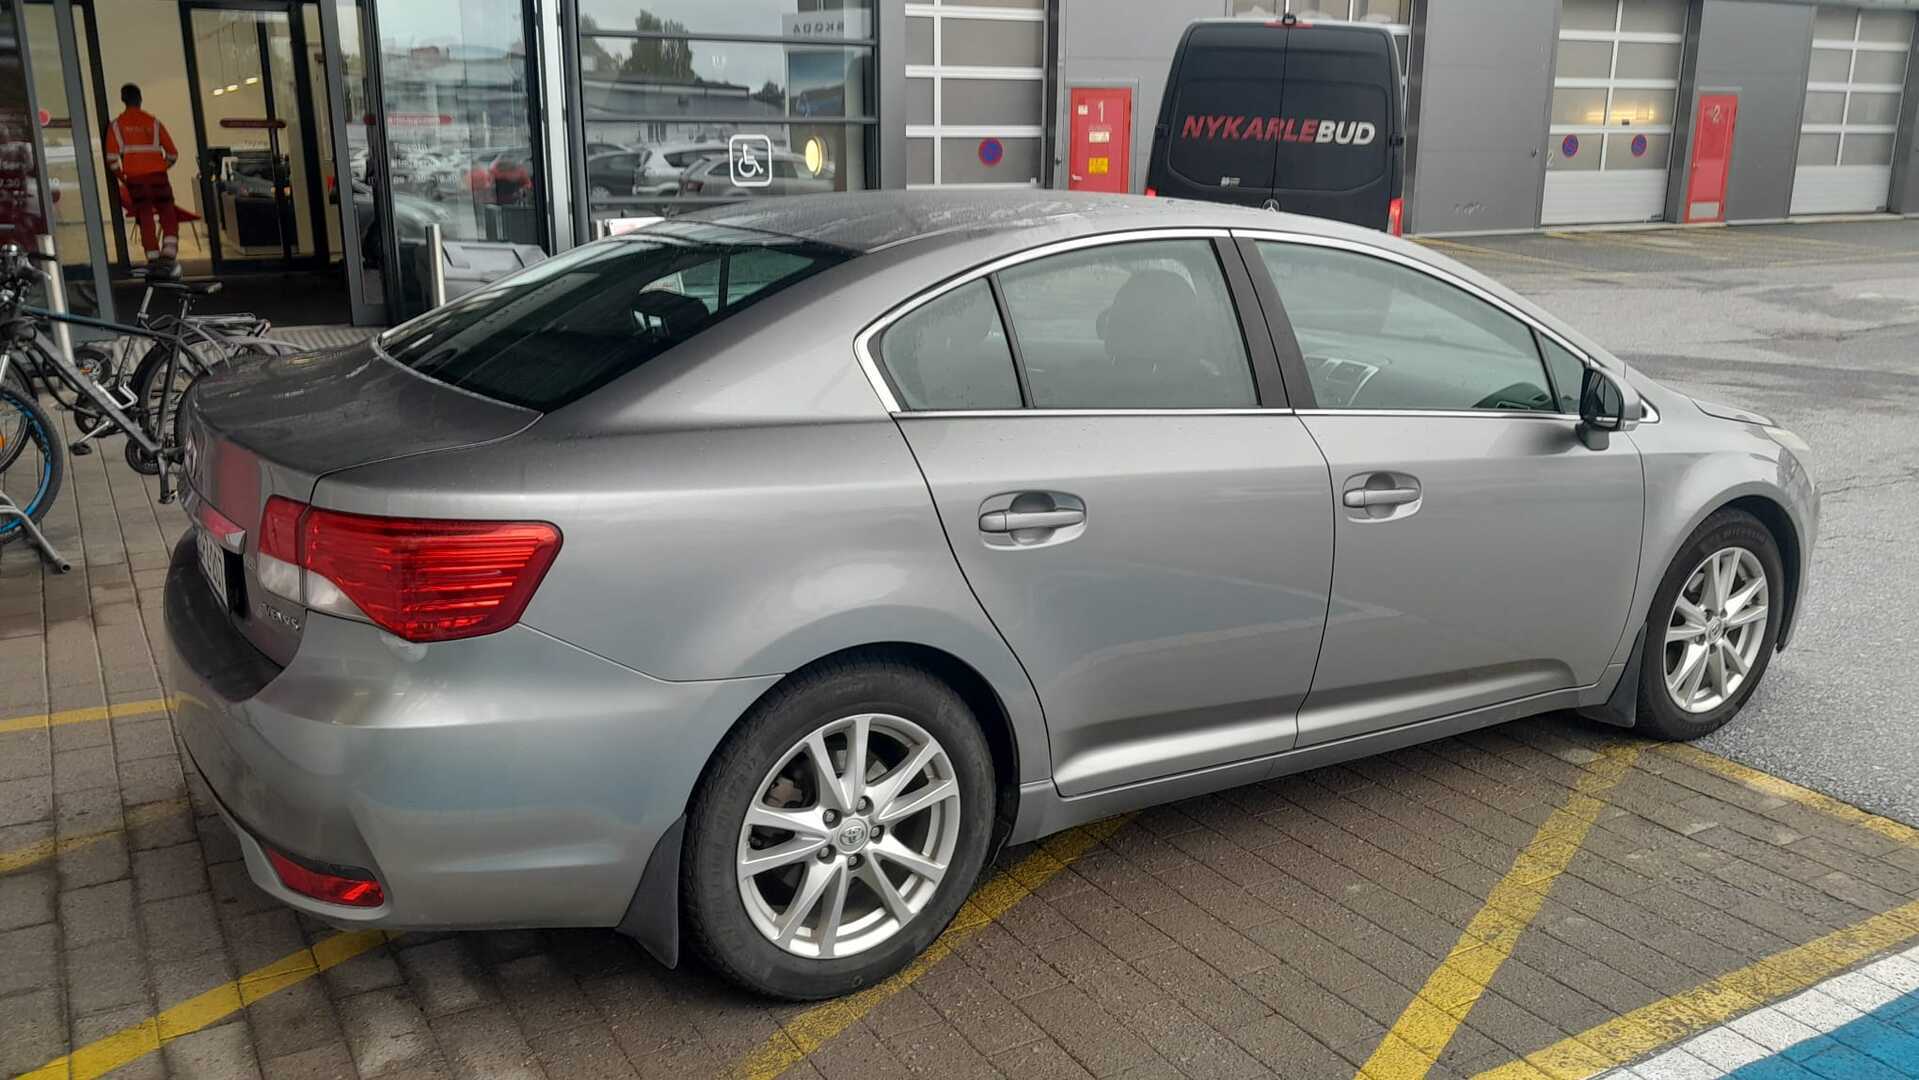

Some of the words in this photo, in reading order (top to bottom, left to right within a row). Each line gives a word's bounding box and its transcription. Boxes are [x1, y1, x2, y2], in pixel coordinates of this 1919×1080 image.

[1098, 99, 1104, 123] 1
[1712, 104, 1721, 123] 2
[1181, 114, 1376, 146] NYKARLEBUD
